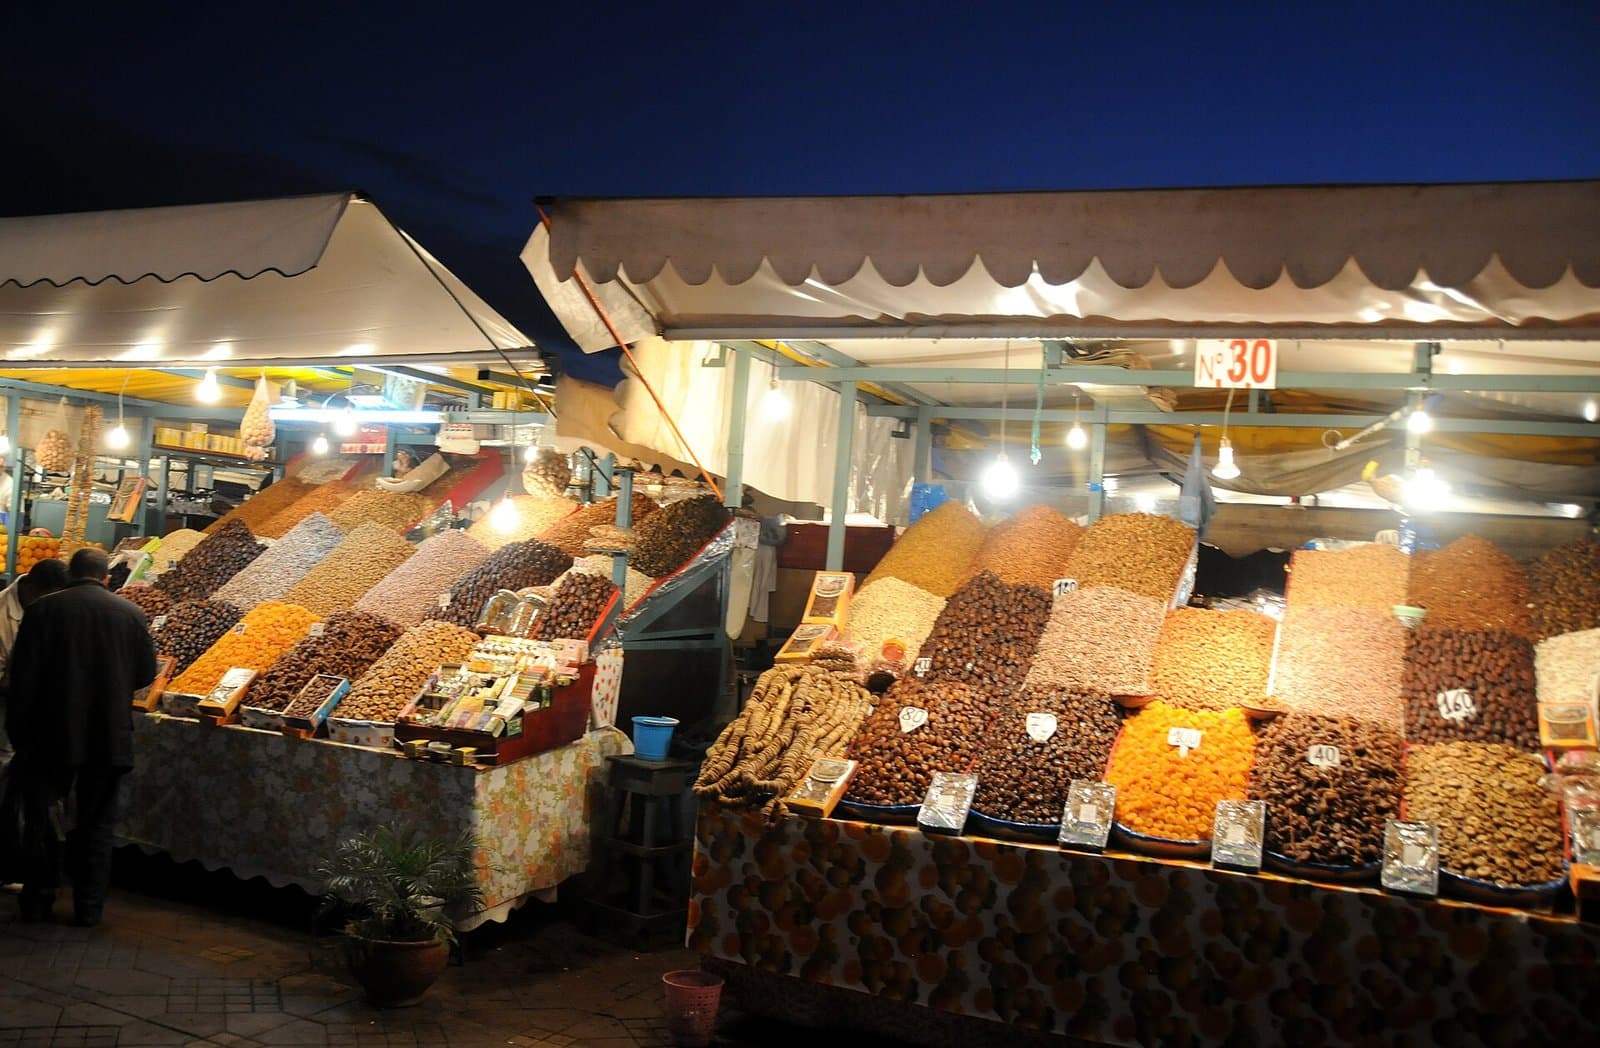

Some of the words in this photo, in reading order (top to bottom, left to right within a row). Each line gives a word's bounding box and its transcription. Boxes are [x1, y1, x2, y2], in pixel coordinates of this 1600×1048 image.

[1227, 338, 1272, 384] 30
[901, 707, 925, 723] 80
[1315, 747, 1336, 762] 40
